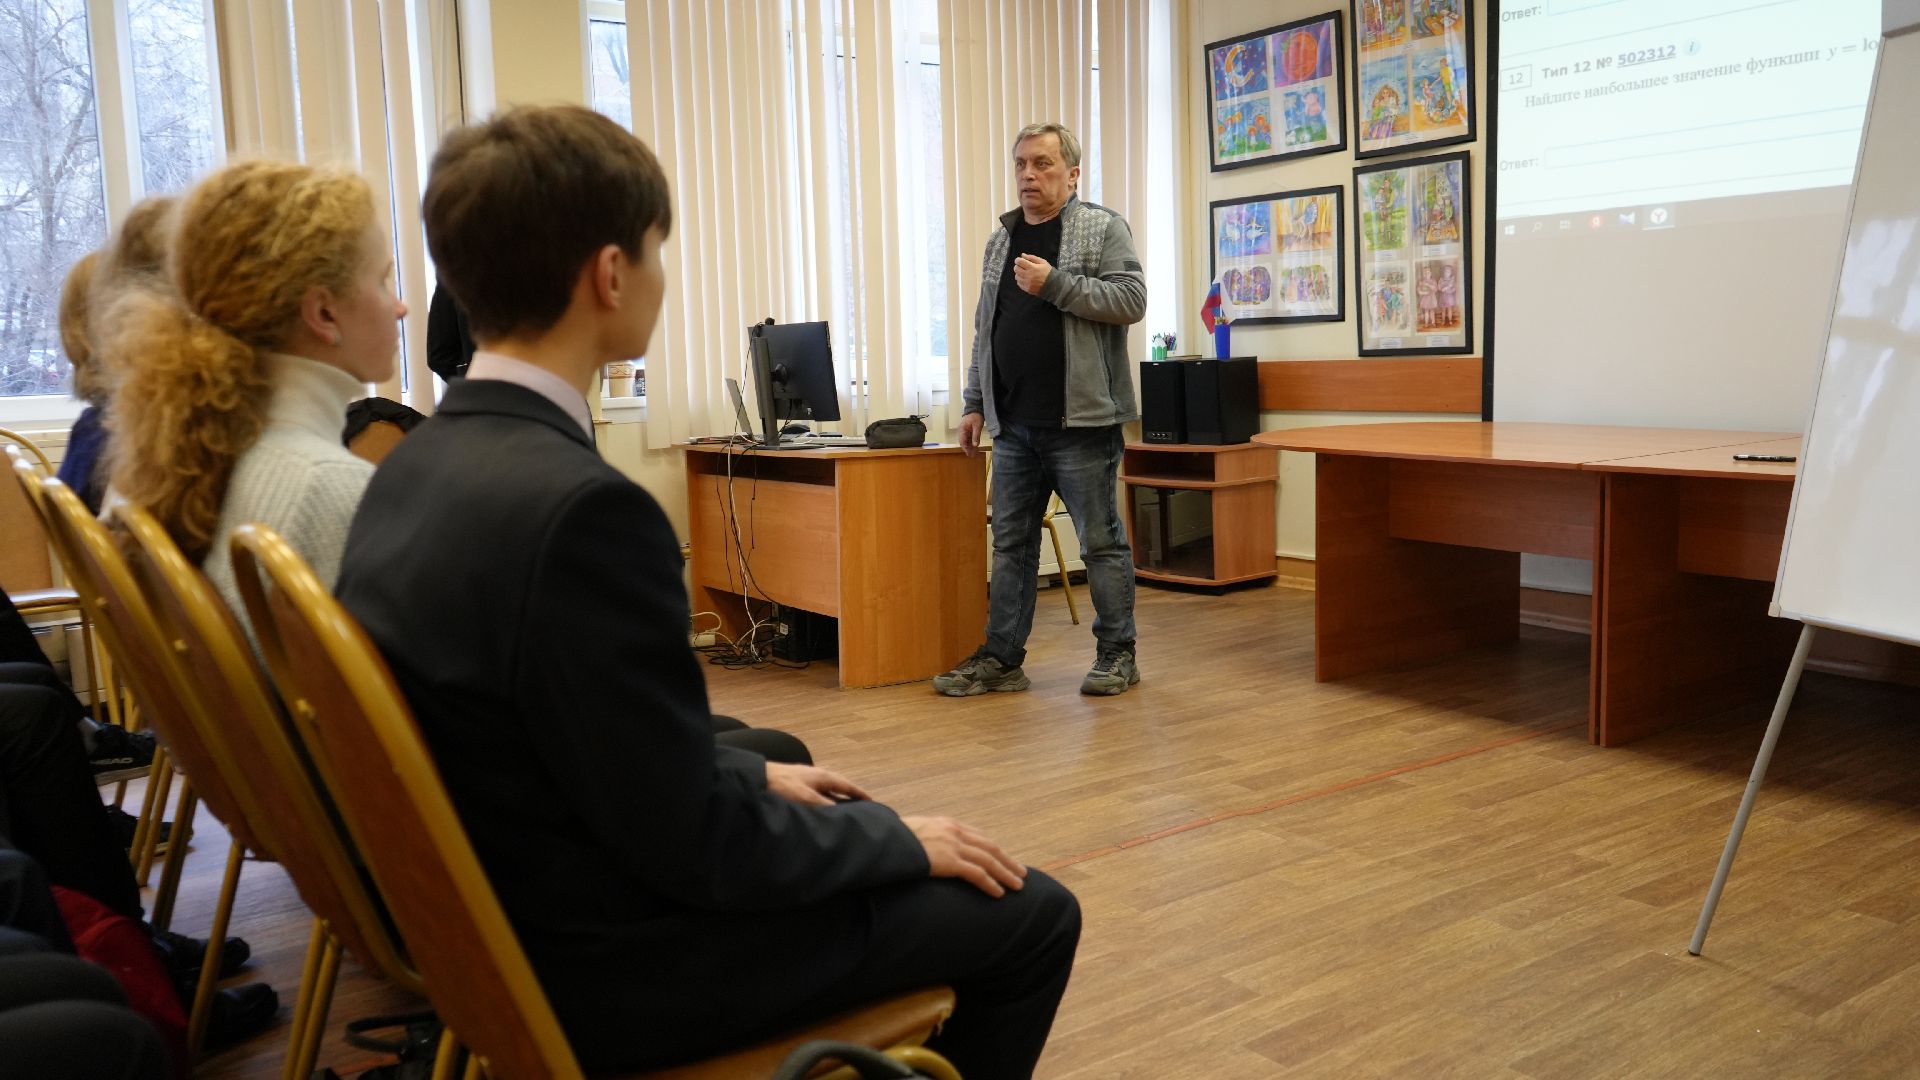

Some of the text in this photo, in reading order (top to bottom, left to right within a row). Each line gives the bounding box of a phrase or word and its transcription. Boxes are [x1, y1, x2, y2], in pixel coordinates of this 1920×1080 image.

[1501, 6, 1542, 22] Ответ:
[1509, 73, 1524, 85] 12
[1541, 66, 1568, 79] Тип
[1573, 61, 1591, 74] 12
[1596, 56, 1613, 70] №
[1617, 44, 1676, 67] 502312
[1524, 90, 1581, 108] Найдите
[1584, 75, 1669, 99] наибольшее
[1673, 62, 1742, 83] значение
[1746, 49, 1821, 75] функции
[1826, 46, 1837, 61] y
[1499, 158, 1540, 172] Ответ:
